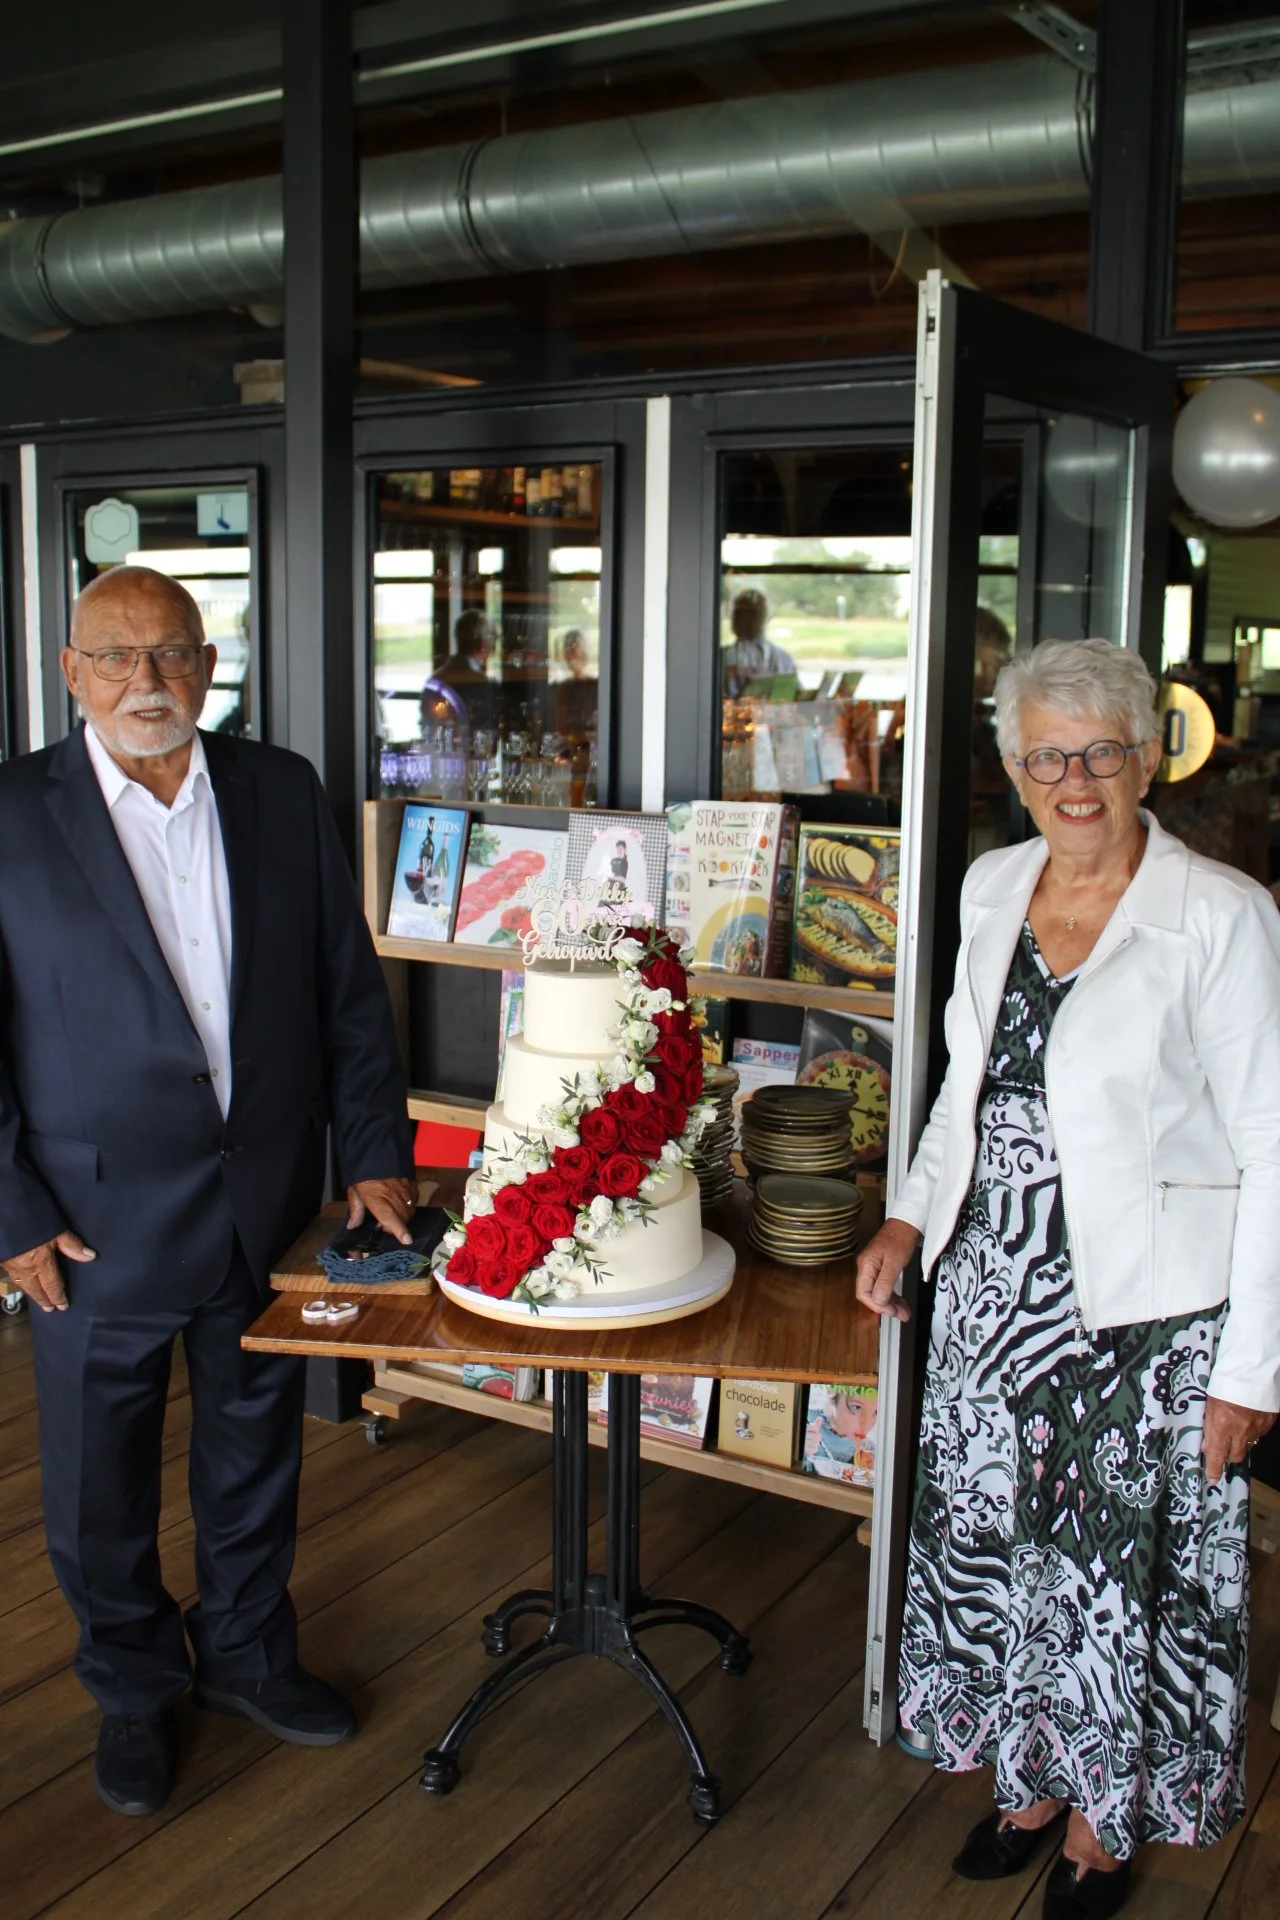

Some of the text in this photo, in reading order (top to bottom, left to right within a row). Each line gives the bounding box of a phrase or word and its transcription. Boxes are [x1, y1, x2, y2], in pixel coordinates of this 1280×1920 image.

[697, 809, 725, 828] STAP
[751, 811, 776, 830] STAP
[530, 898, 585, 936] 60
[725, 1388, 786, 1413] chocolade
